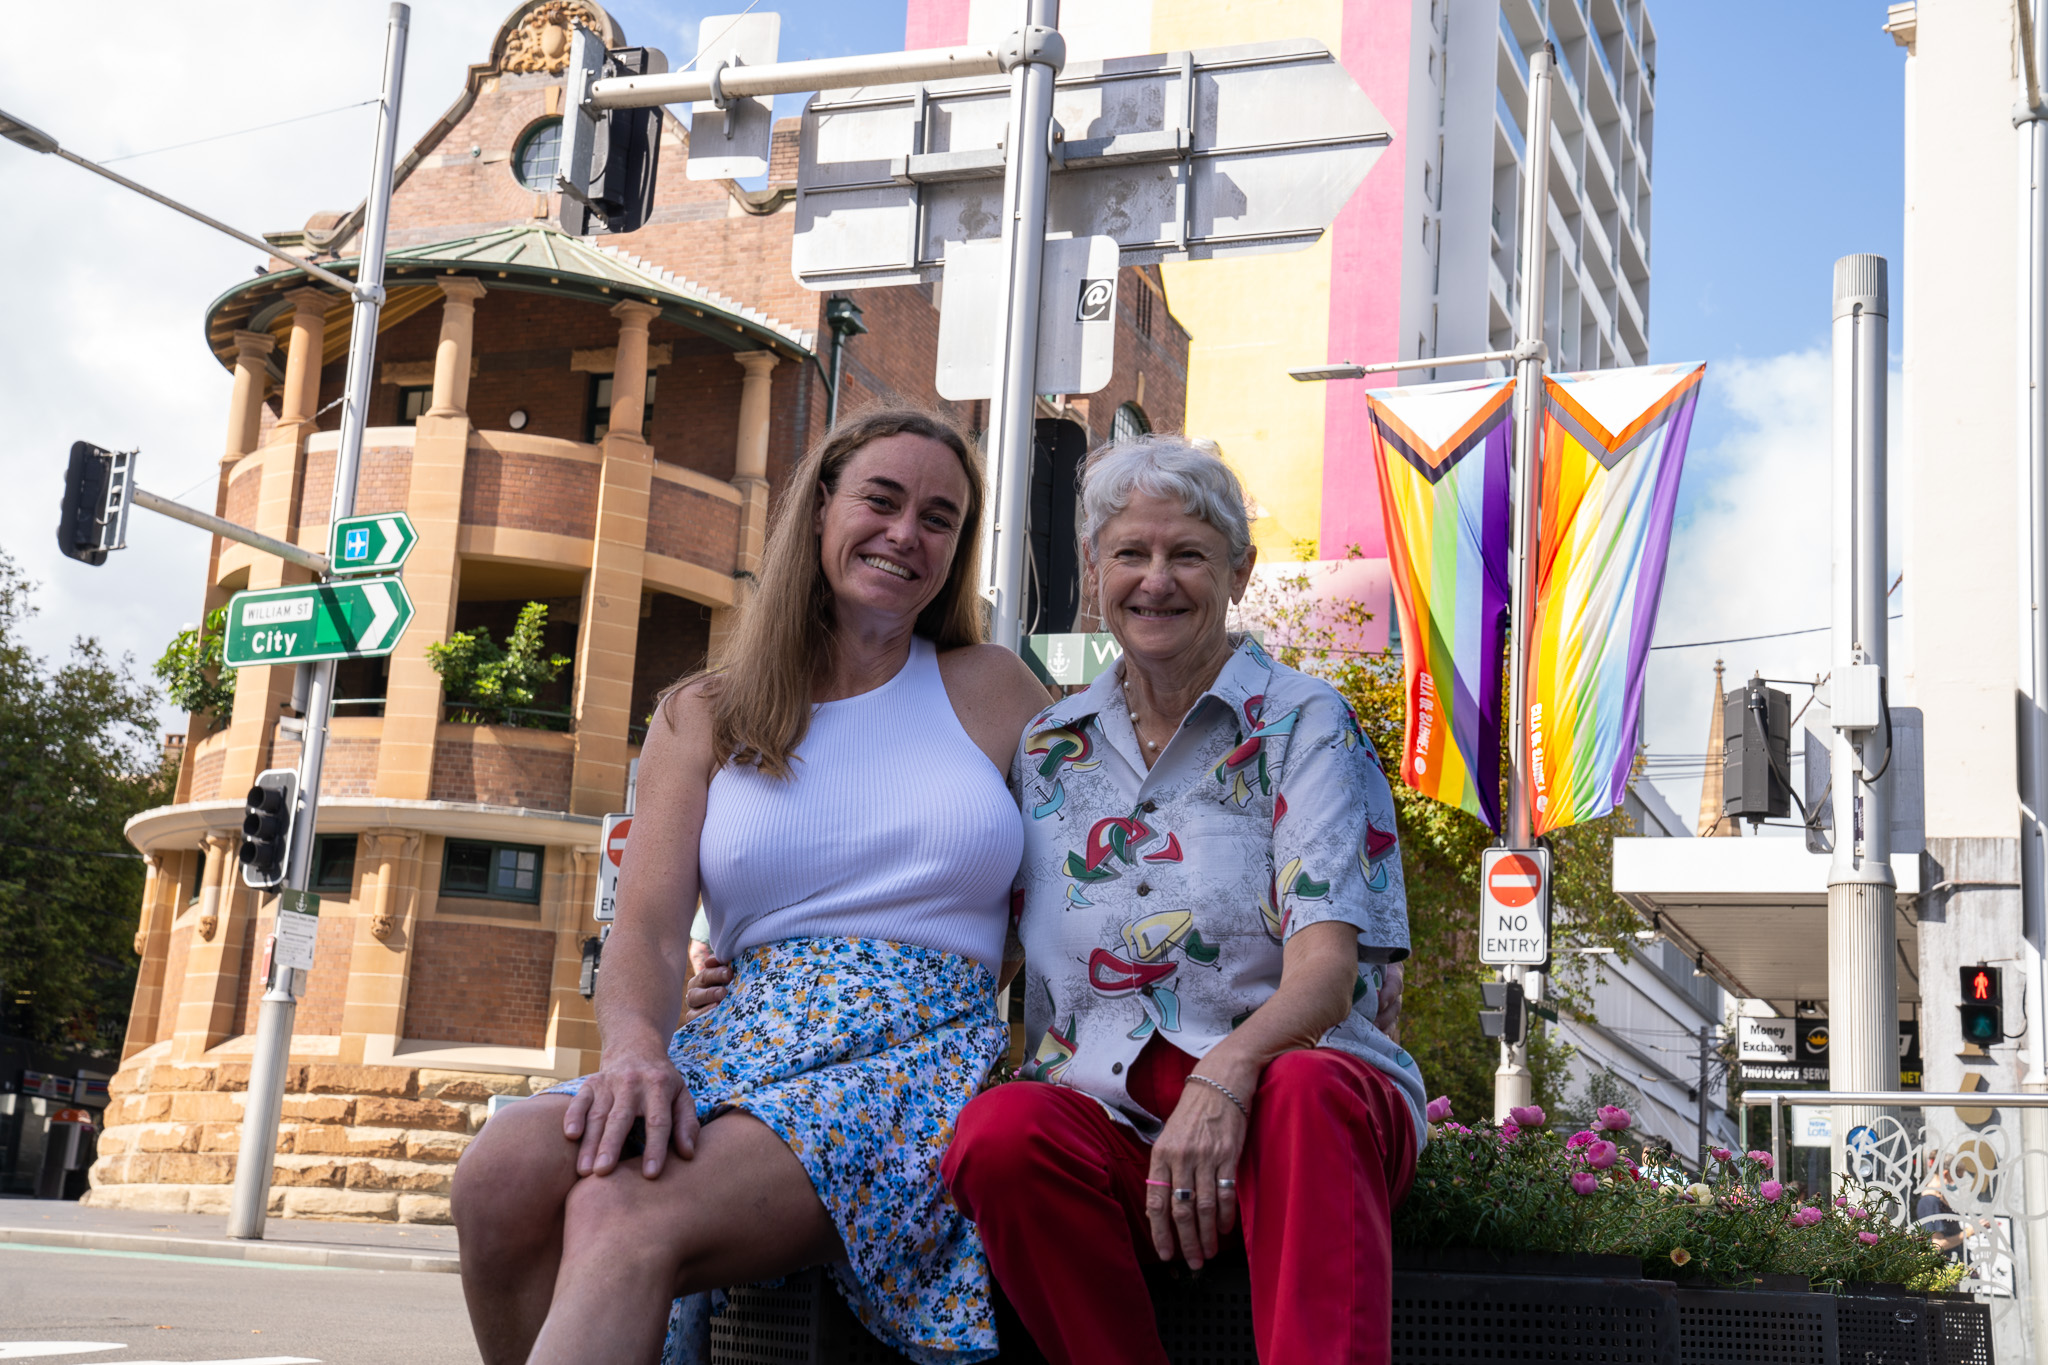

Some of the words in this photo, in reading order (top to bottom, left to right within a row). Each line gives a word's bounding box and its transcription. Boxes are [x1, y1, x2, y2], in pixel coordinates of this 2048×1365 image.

[248, 604, 292, 619] WILLIAM
[297, 602, 309, 615] ST
[252, 630, 297, 656] City
[1499, 915, 1528, 931] NO
[1487, 938, 1540, 952] ENTRY
[1750, 1024, 1785, 1039] Money
[1743, 1041, 1793, 1055] Exchange
[1742, 1065, 1773, 1079] PHOTO
[1774, 1066, 1800, 1080] COPY
